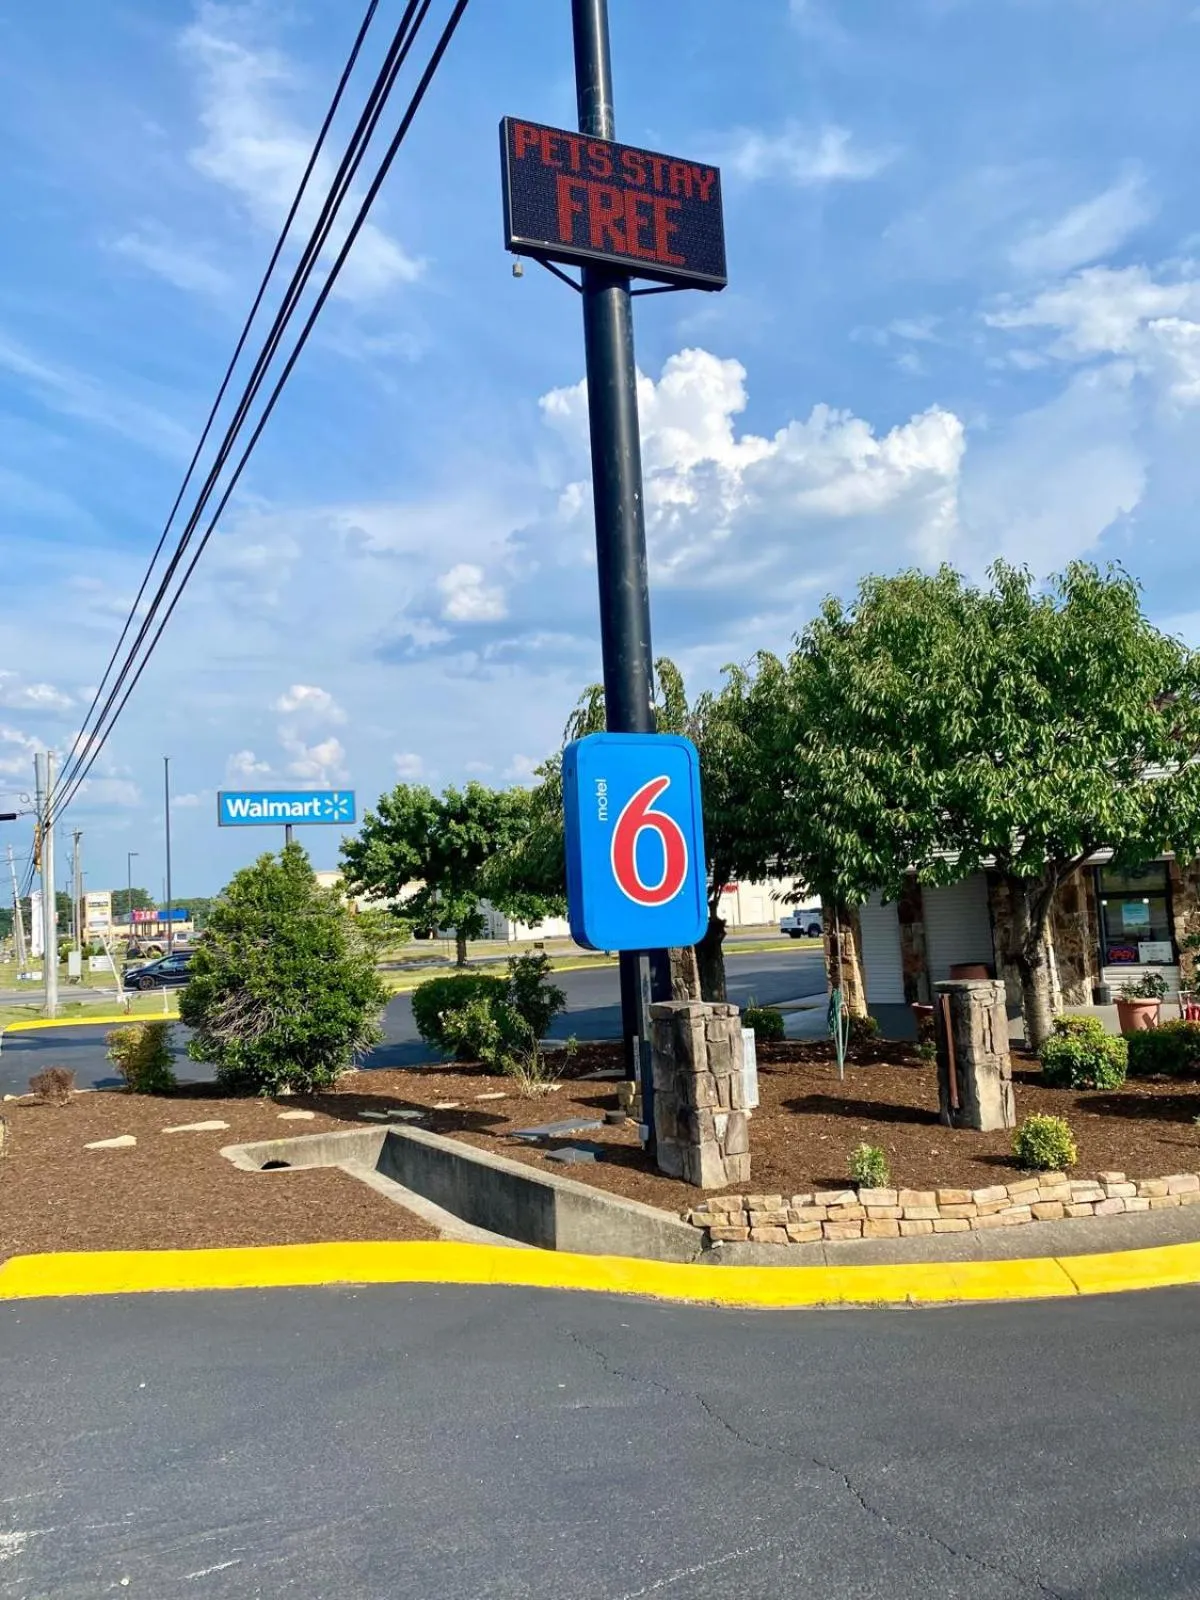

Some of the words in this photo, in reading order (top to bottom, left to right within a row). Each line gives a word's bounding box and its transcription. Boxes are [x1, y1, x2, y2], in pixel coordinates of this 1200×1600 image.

[513, 122, 613, 178] PETS
[620, 150, 715, 201] STAY
[556, 174, 686, 265] FREE
[226, 797, 322, 818] Walmart
[595, 778, 608, 821] motel
[610, 775, 688, 907] 6
[1109, 949, 1135, 960] OPEN
